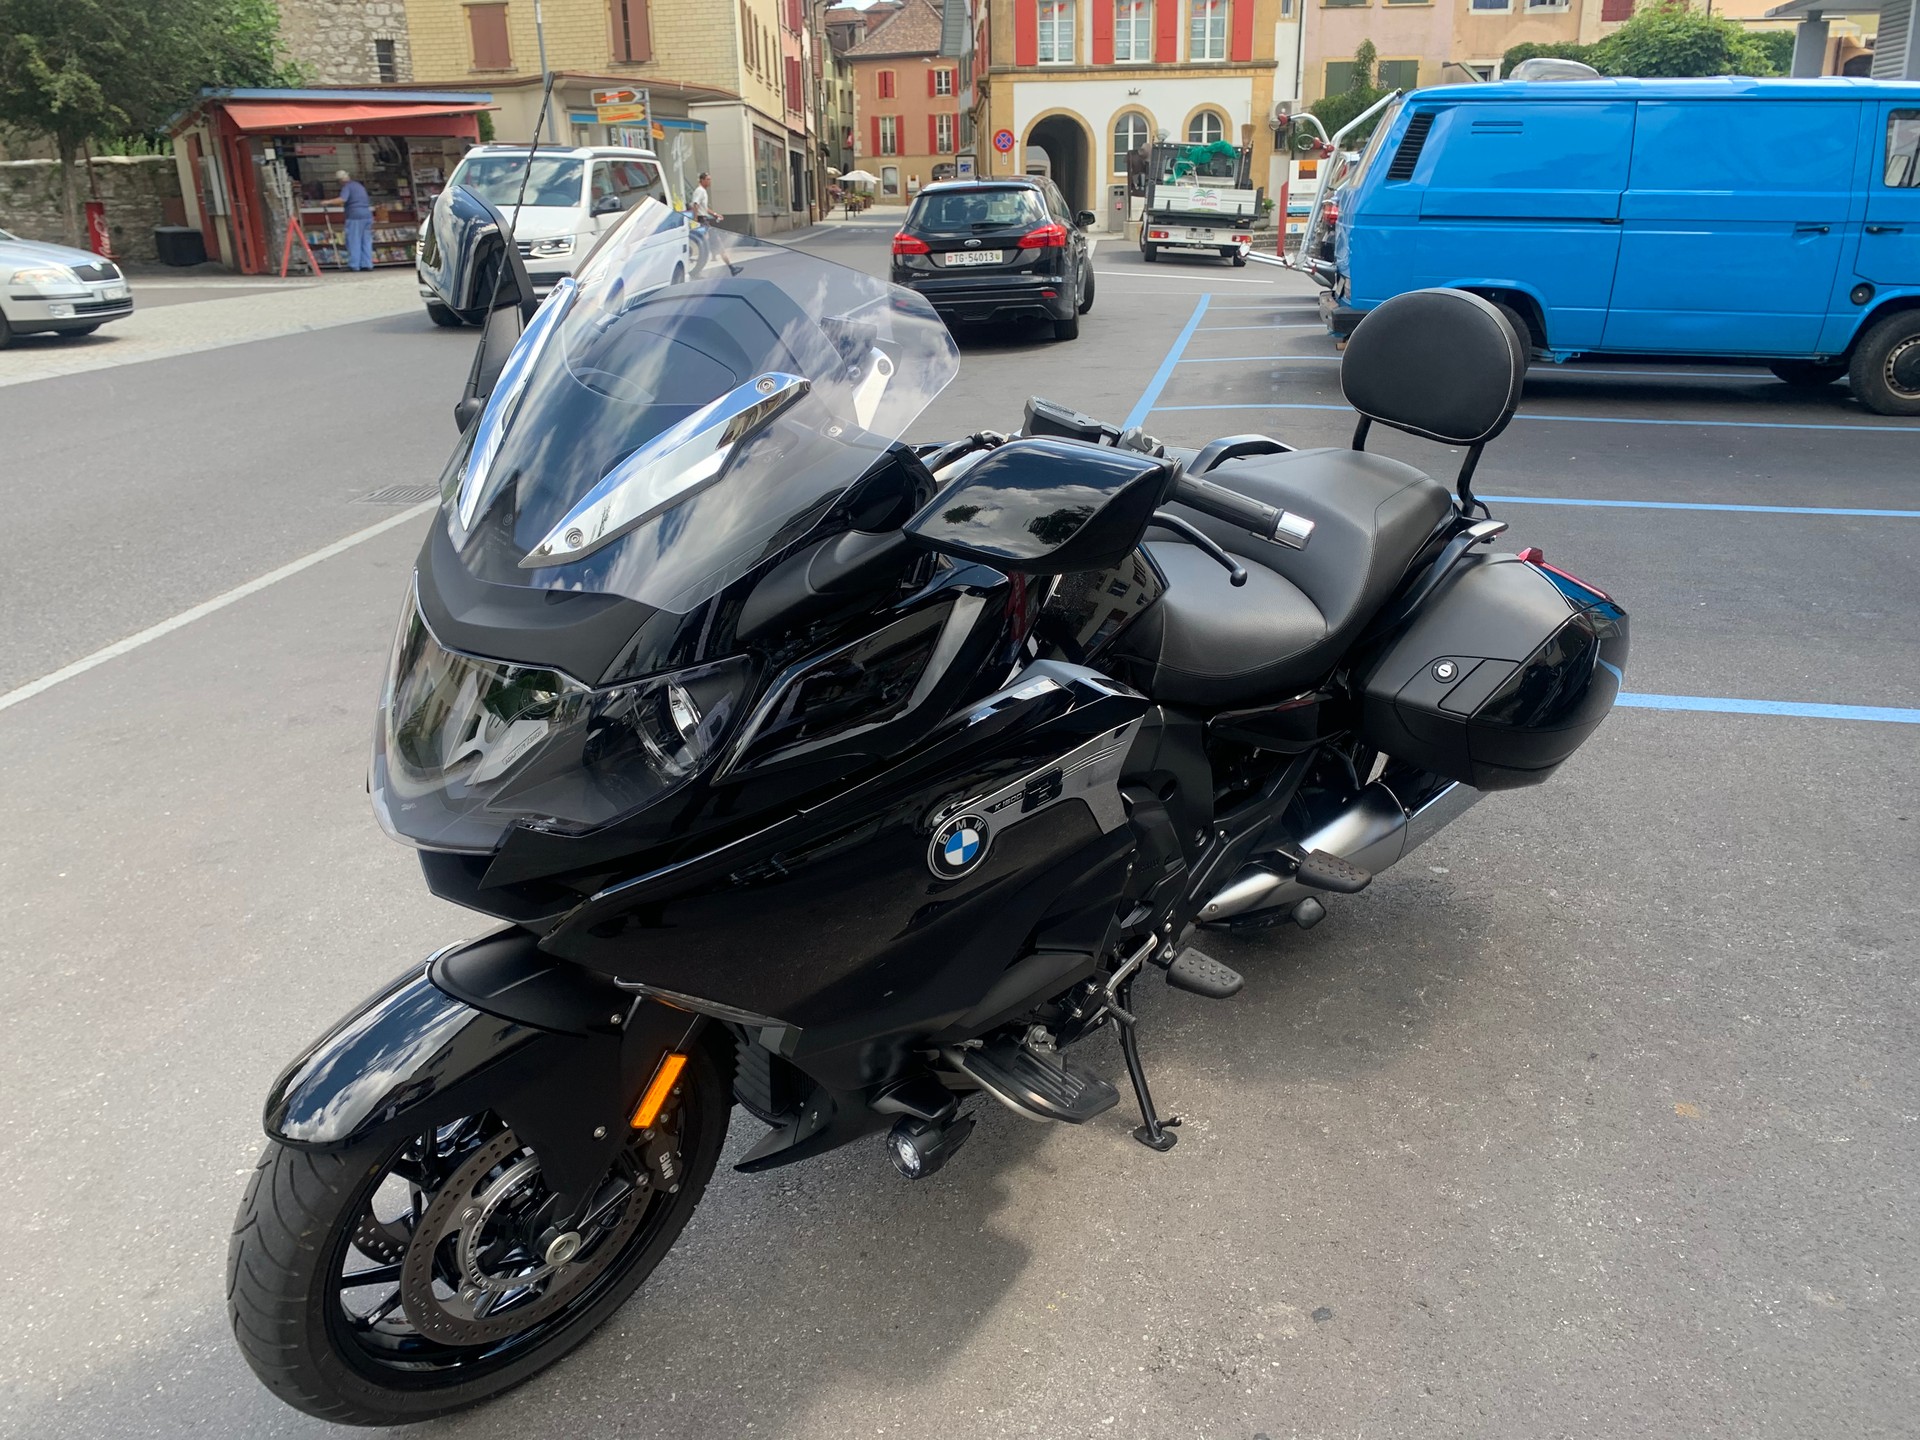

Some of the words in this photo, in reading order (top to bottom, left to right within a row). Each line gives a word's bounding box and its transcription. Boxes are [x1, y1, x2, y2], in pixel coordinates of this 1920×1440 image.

[968, 252, 994, 263] 54013
[938, 818, 985, 845] BMW
[659, 1151, 674, 1180] BMW
